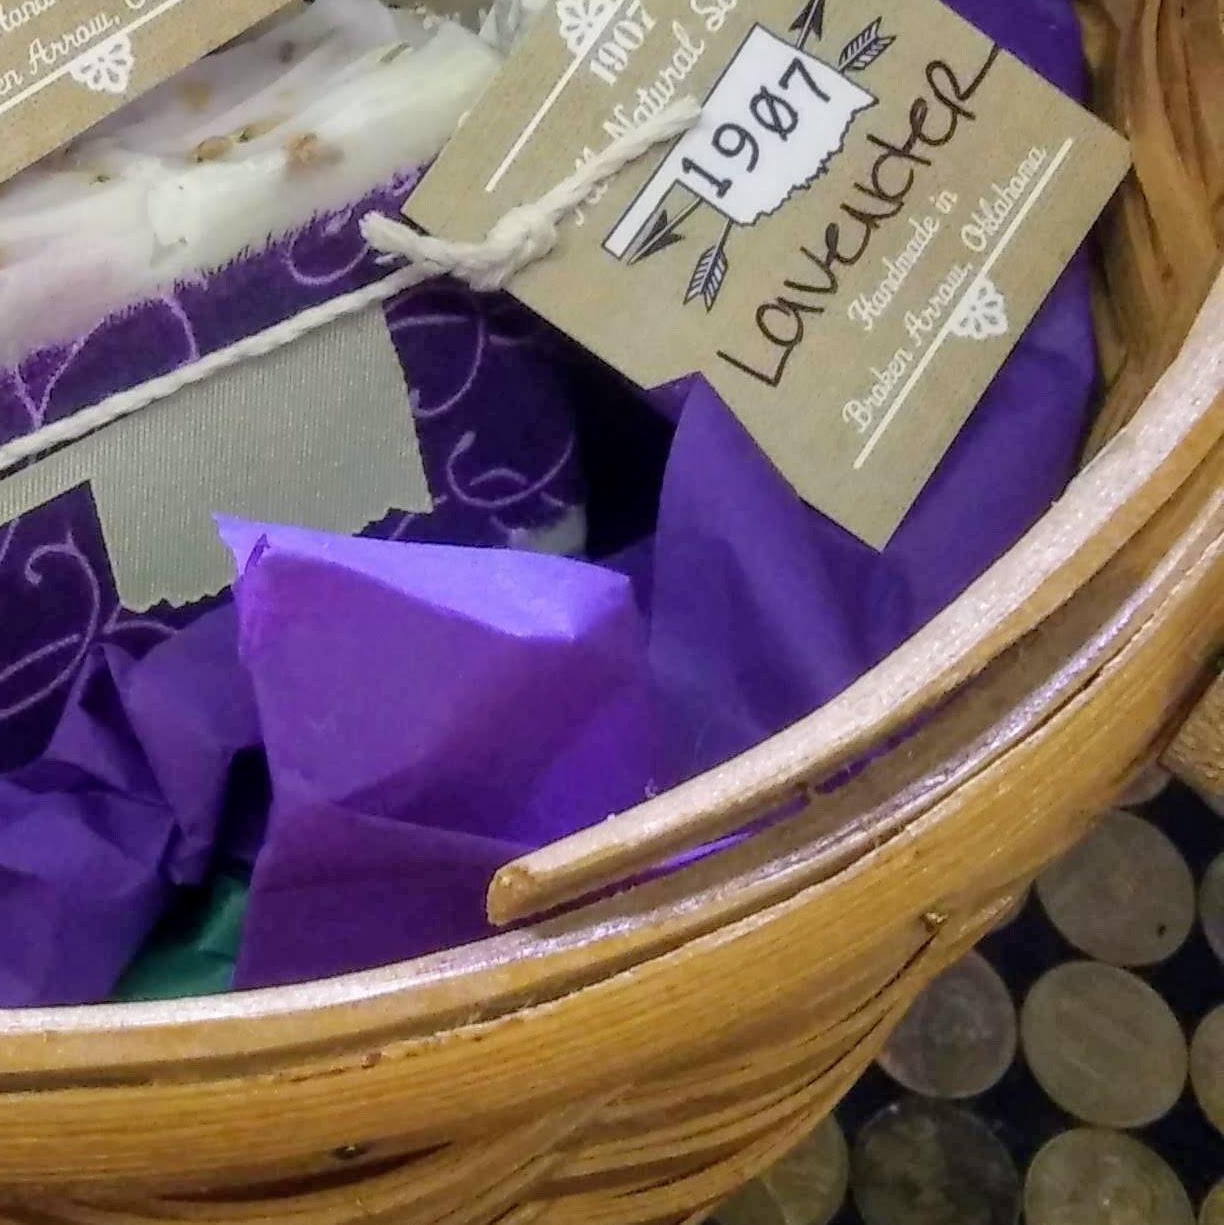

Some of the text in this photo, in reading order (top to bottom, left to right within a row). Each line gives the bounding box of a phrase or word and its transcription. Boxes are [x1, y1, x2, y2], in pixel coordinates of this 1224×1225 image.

[26, 10, 121, 75] Arrow,
[681, 57, 831, 198] 1907
[841, 145, 1048, 435] Broken Arrow, Oklahoma
[847, 188, 959, 332] Handmade in
